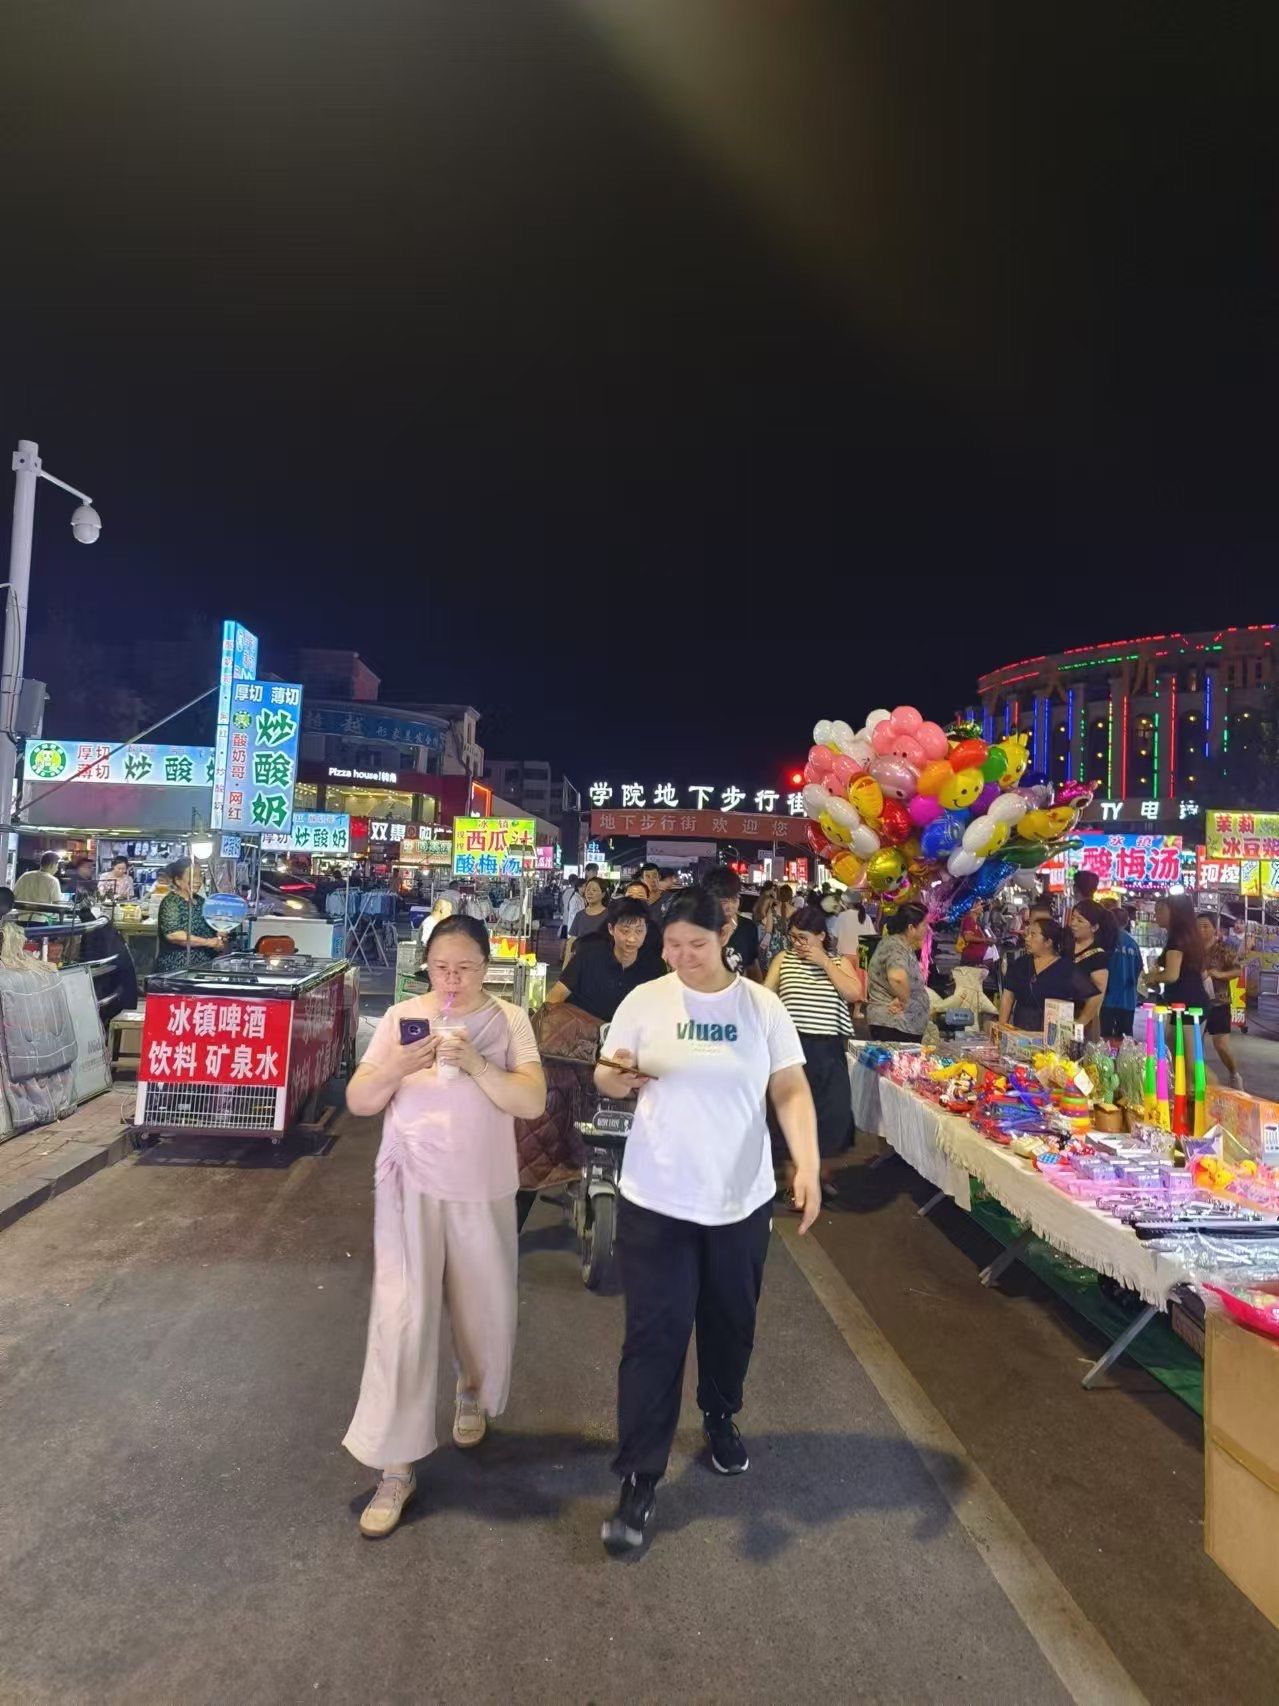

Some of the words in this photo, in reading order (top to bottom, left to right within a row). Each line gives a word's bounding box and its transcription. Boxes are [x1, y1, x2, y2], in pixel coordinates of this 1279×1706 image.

[235, 684, 264, 702] 厚切
[271, 686, 300, 706] 薄切
[77, 745, 110, 760] 厚切
[252, 708, 297, 828] 炒酸奶
[328, 767, 352, 778] Pizza
[589, 782, 808, 818] 学院地下步行街
[600, 815, 697, 831] 地下步行街
[712, 817, 788, 837] 欢迎您
[1215, 814, 1255, 834] 茉莉
[294, 827, 347, 848] 炒酸奶
[466, 830, 534, 852] 西瓜汁
[456, 854, 522, 876] 酸梅汤
[1081, 847, 1180, 880] 酸梅汤
[167, 1001, 267, 1039] 冰镇啤酒
[148, 1040, 197, 1077] 饮料
[205, 1043, 279, 1080] 矿泉水
